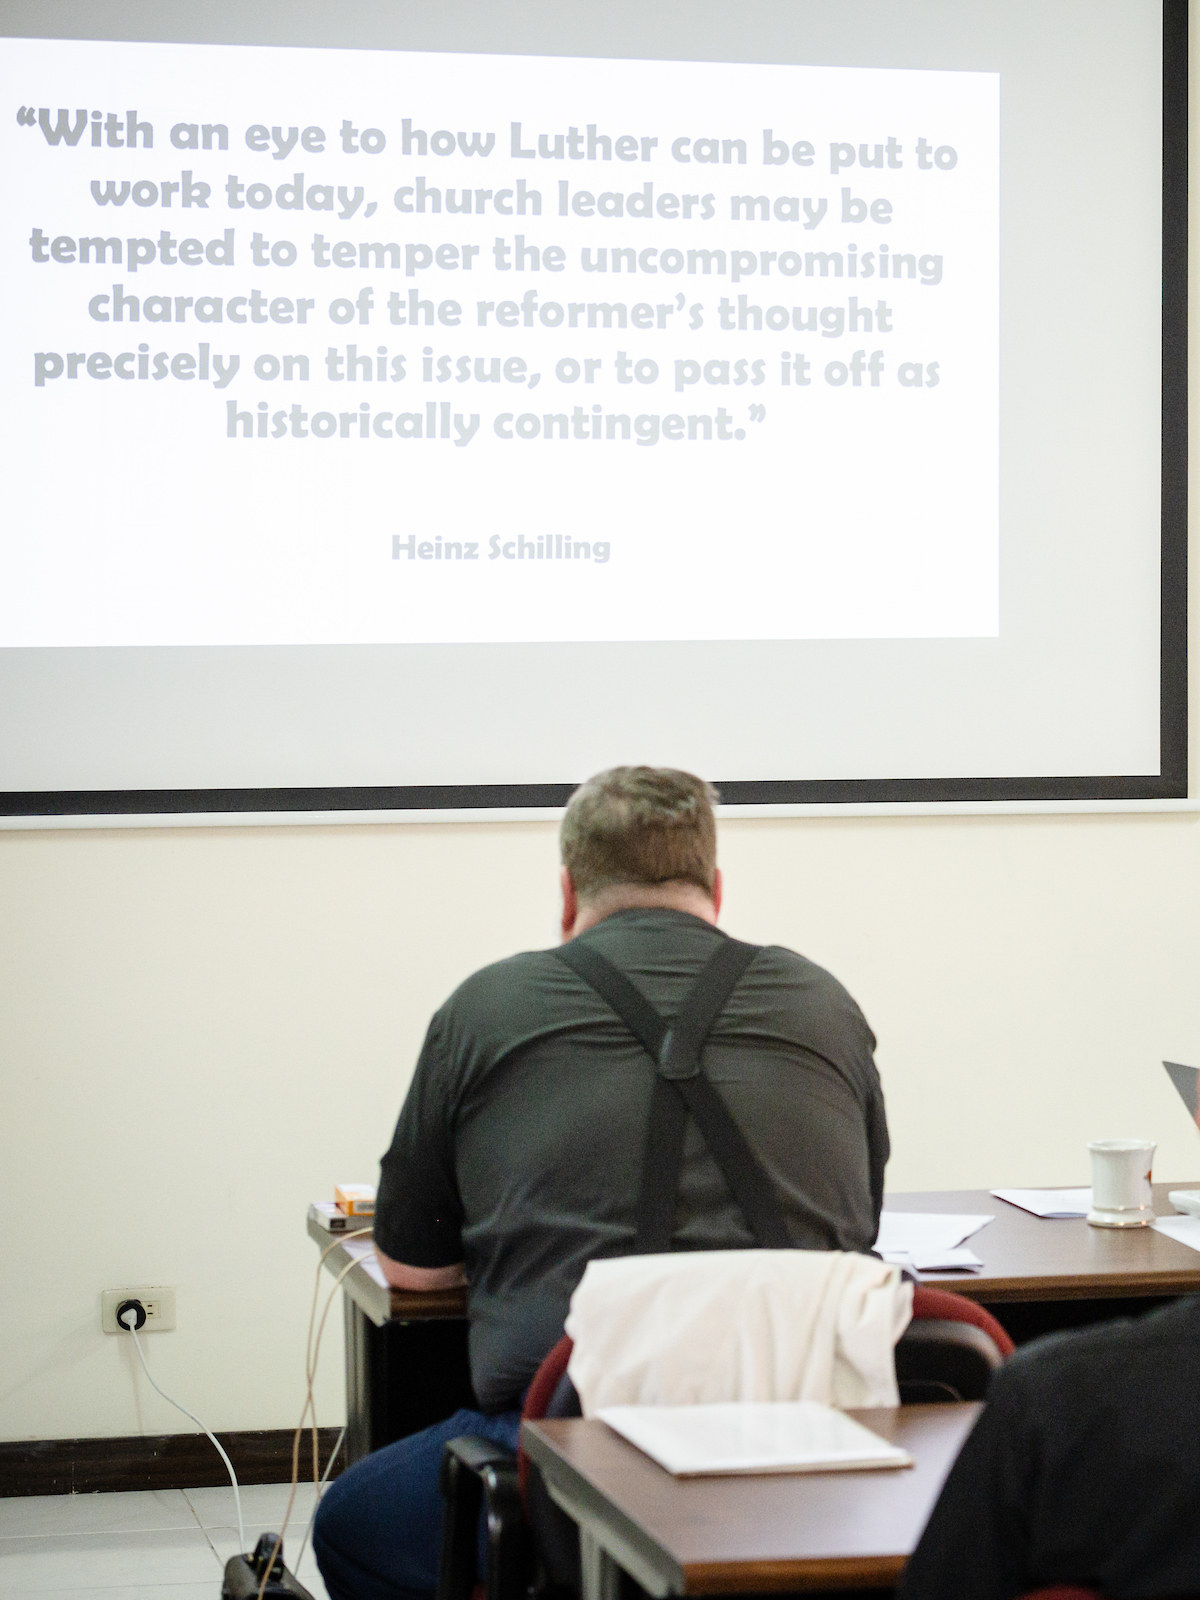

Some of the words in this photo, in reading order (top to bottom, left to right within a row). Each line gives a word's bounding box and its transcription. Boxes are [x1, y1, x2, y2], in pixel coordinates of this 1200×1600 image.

[15, 104, 154, 149] “With
[169, 122, 229, 151] an
[244, 124, 327, 161] eye
[339, 119, 387, 155] to
[401, 118, 496, 157] how
[510, 122, 658, 162] Luther
[671, 137, 747, 164] can
[763, 129, 815, 167] be
[829, 136, 903, 175] put
[915, 137, 958, 170] to
[90, 169, 212, 209] work
[225, 172, 378, 220] today,
[393, 176, 542, 216] church
[558, 180, 715, 220] leaders
[730, 195, 828, 230] may
[841, 187, 893, 224] be
[28, 227, 235, 273] tempted
[250, 232, 298, 267] to
[311, 233, 480, 277] temper
[492, 234, 566, 272] the
[581, 243, 943, 285] uncompromising
[88, 283, 315, 324] character
[328, 286, 374, 325] of
[387, 288, 462, 327] the
[477, 289, 704, 330] reformer’s
[718, 294, 893, 338] thought
[33, 342, 240, 389] precisely
[253, 354, 310, 381] on
[325, 344, 406, 382] this
[422, 346, 541, 389] issue,
[555, 358, 602, 383] or
[614, 351, 659, 384] to
[674, 359, 765, 392] pass
[781, 351, 811, 386] it
[824, 350, 884, 387] off
[897, 361, 940, 388] as
[226, 400, 480, 447] historically
[494, 403, 766, 446] contingent.”
[392, 535, 479, 560] Heinz
[488, 534, 610, 563] Schilling
